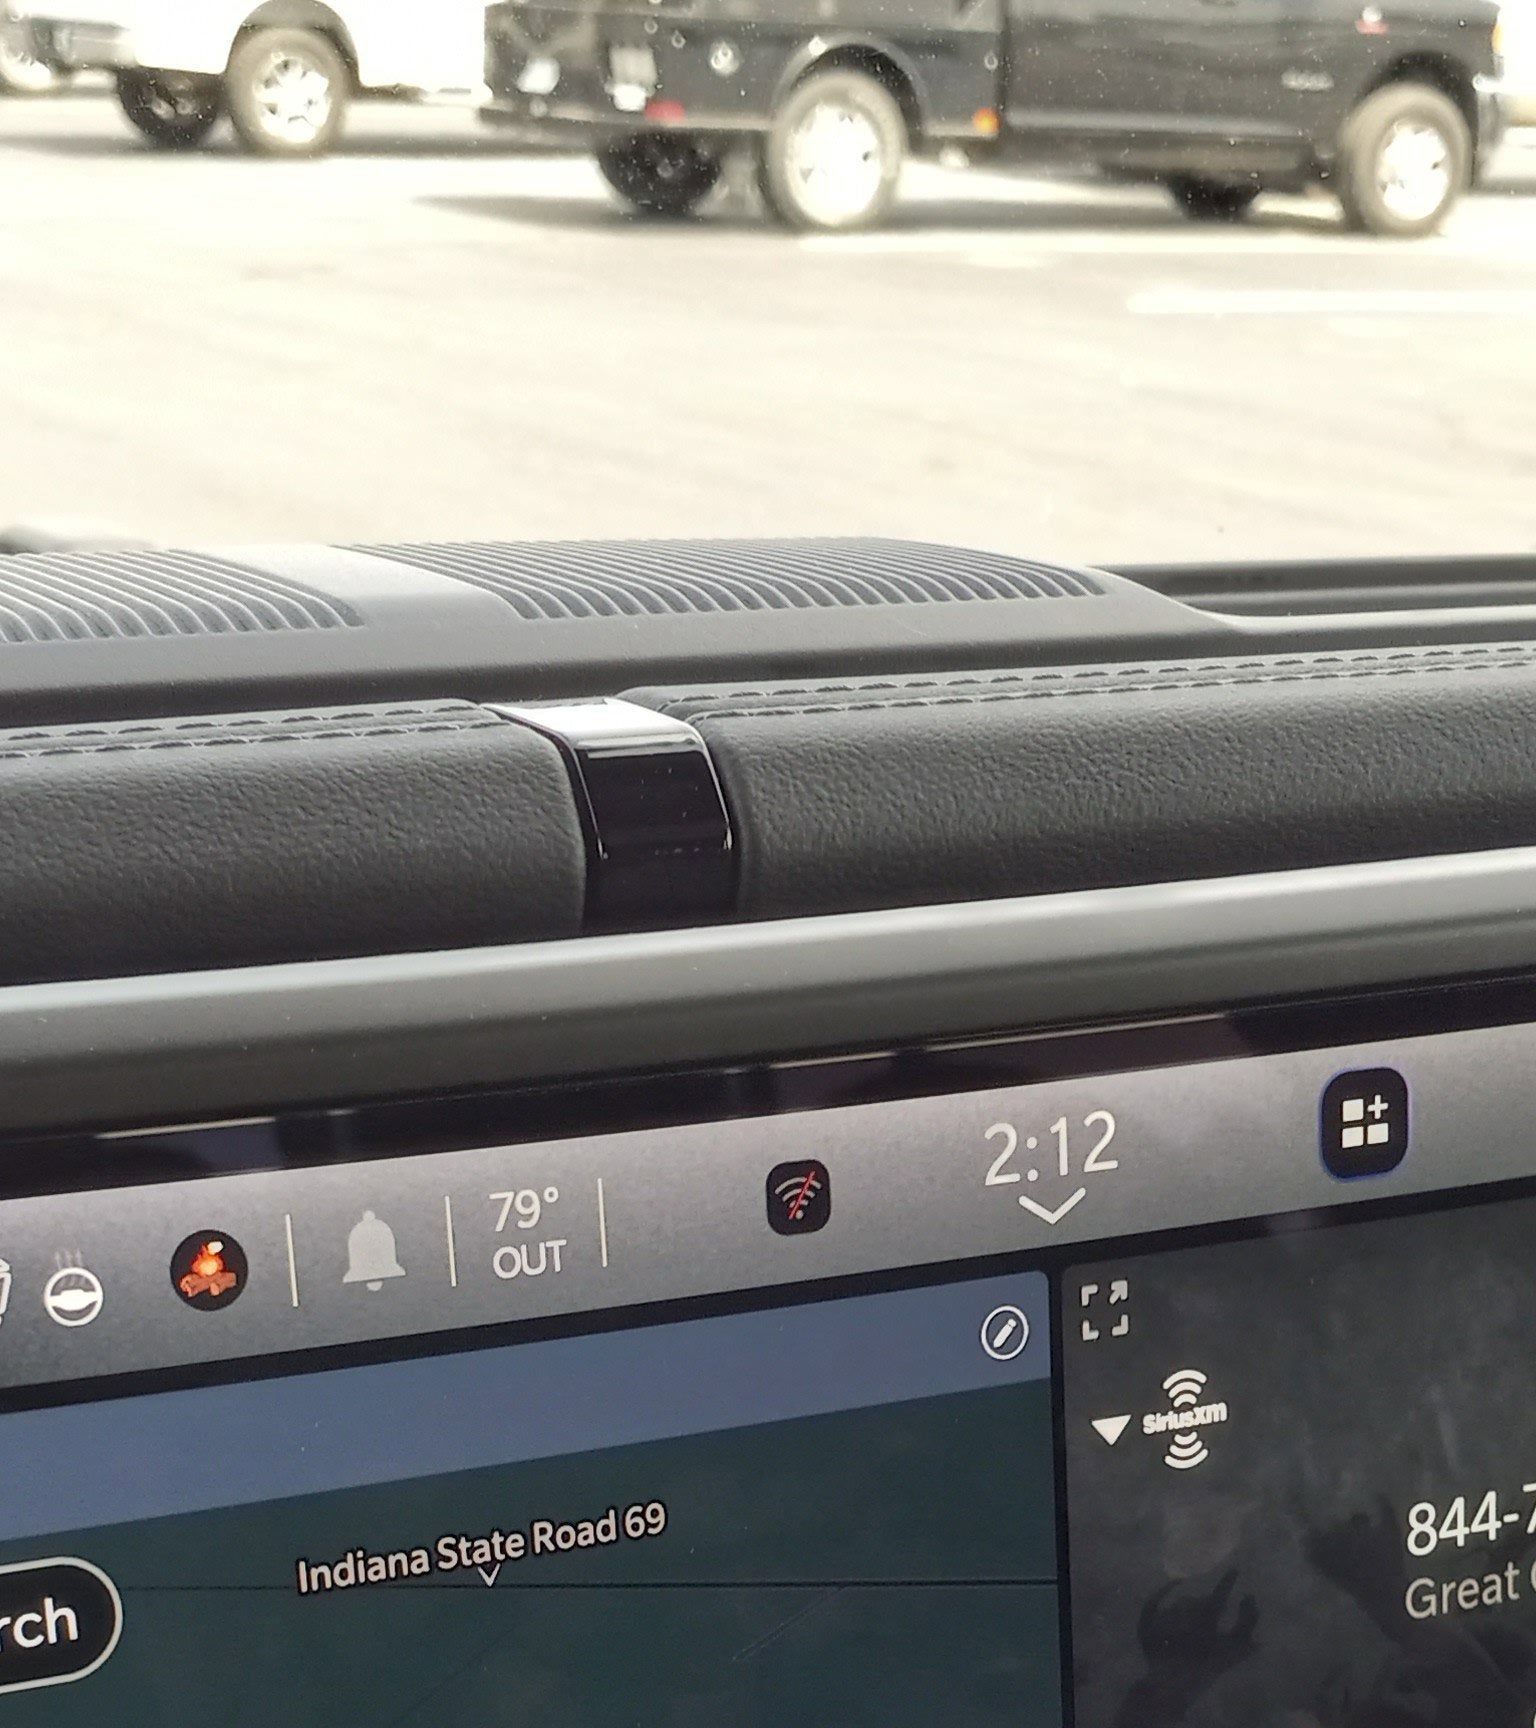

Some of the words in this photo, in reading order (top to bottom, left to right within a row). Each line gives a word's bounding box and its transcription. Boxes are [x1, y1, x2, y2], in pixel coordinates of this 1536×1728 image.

[984, 1111, 1119, 1187] 2:12
[492, 1240, 567, 1280] OUT
[298, 1548, 431, 1593] Indiana
[436, 1527, 526, 1570] State
[531, 1509, 618, 1555] Road
[624, 1502, 667, 1537] 69
[1405, 1561, 1519, 1619] Great
